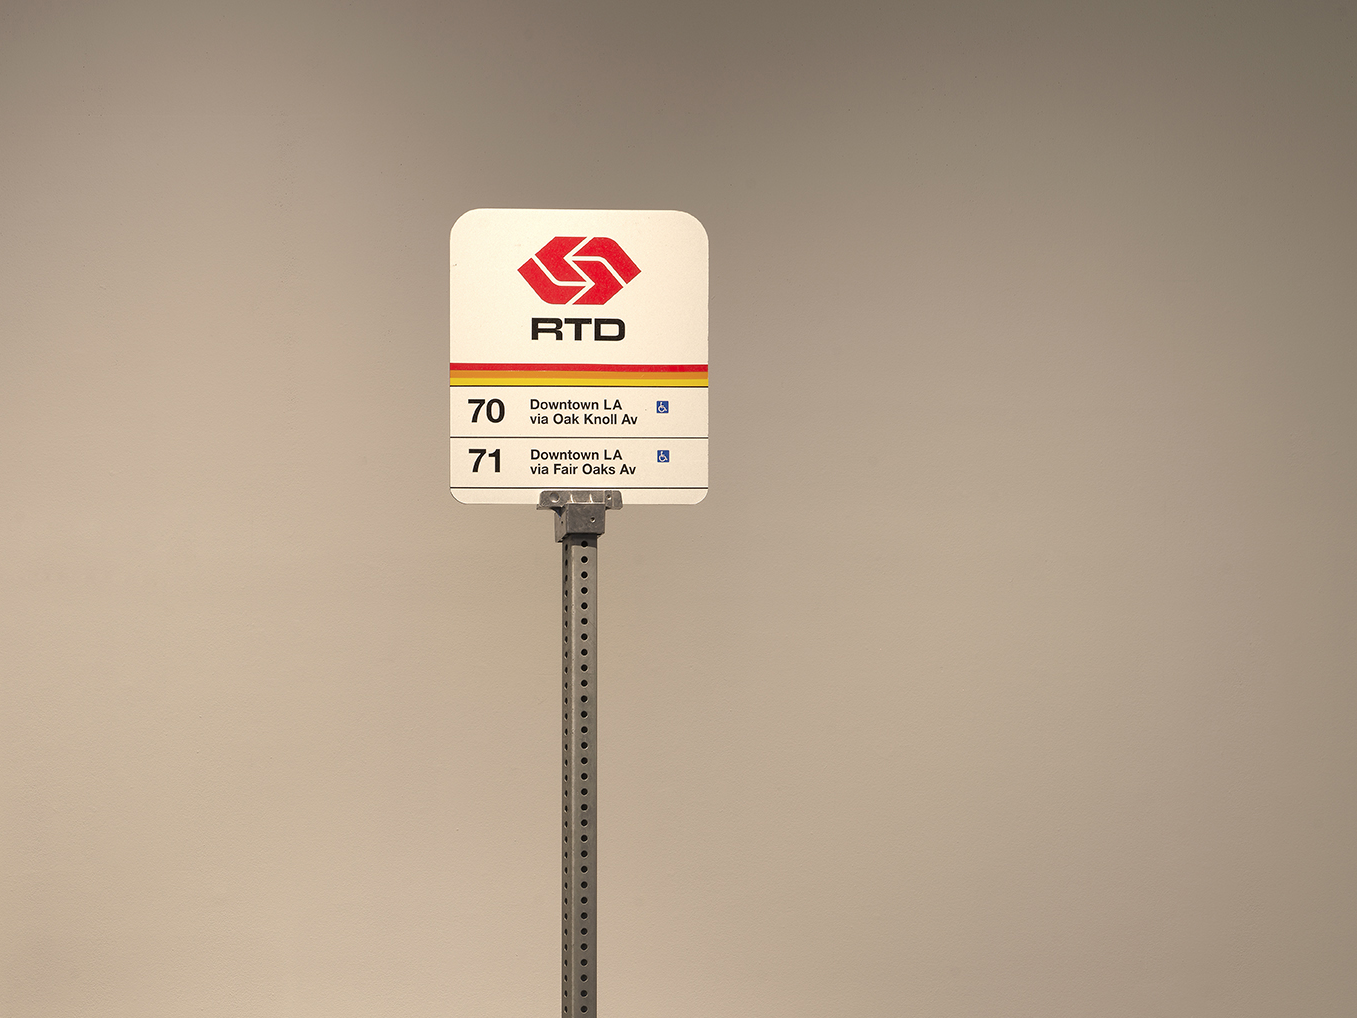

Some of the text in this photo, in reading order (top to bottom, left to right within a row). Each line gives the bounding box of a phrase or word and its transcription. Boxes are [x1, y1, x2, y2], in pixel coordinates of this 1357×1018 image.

[532, 318, 625, 341] RTD
[531, 399, 622, 410] Downtown LA
[468, 399, 504, 423] 70
[530, 414, 637, 424] via Oak Knoll Av
[469, 449, 500, 472] 71
[531, 450, 622, 460] Downtown LA
[531, 464, 636, 474] via Fair Oaks Av
